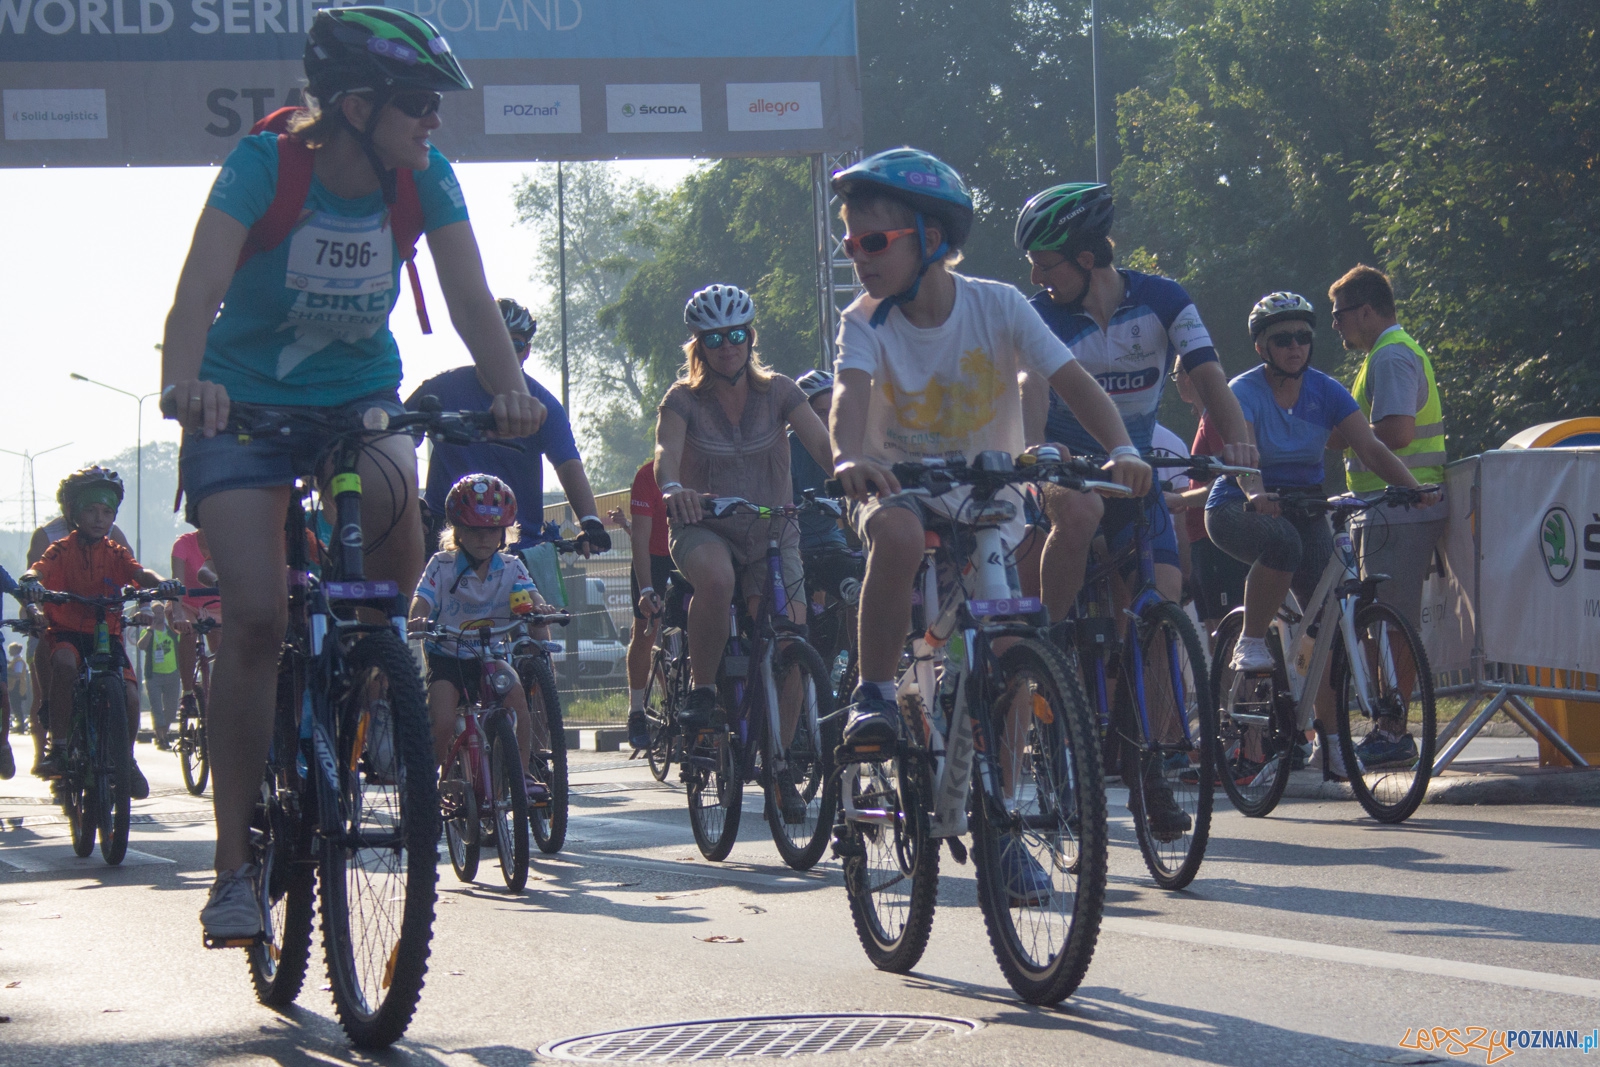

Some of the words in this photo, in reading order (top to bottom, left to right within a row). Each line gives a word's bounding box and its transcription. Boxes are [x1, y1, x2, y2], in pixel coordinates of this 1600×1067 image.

[0, 0, 174, 35] WORLD
[190, 0, 357, 34] SERIE
[414, 0, 582, 32] POLAND
[639, 104, 687, 114] ŠKODA
[748, 99, 800, 116] allegro
[21, 111, 48, 121] Solid
[51, 111, 99, 122] Logistics
[1095, 374, 1145, 391] orda
[608, 594, 631, 605] CHR
